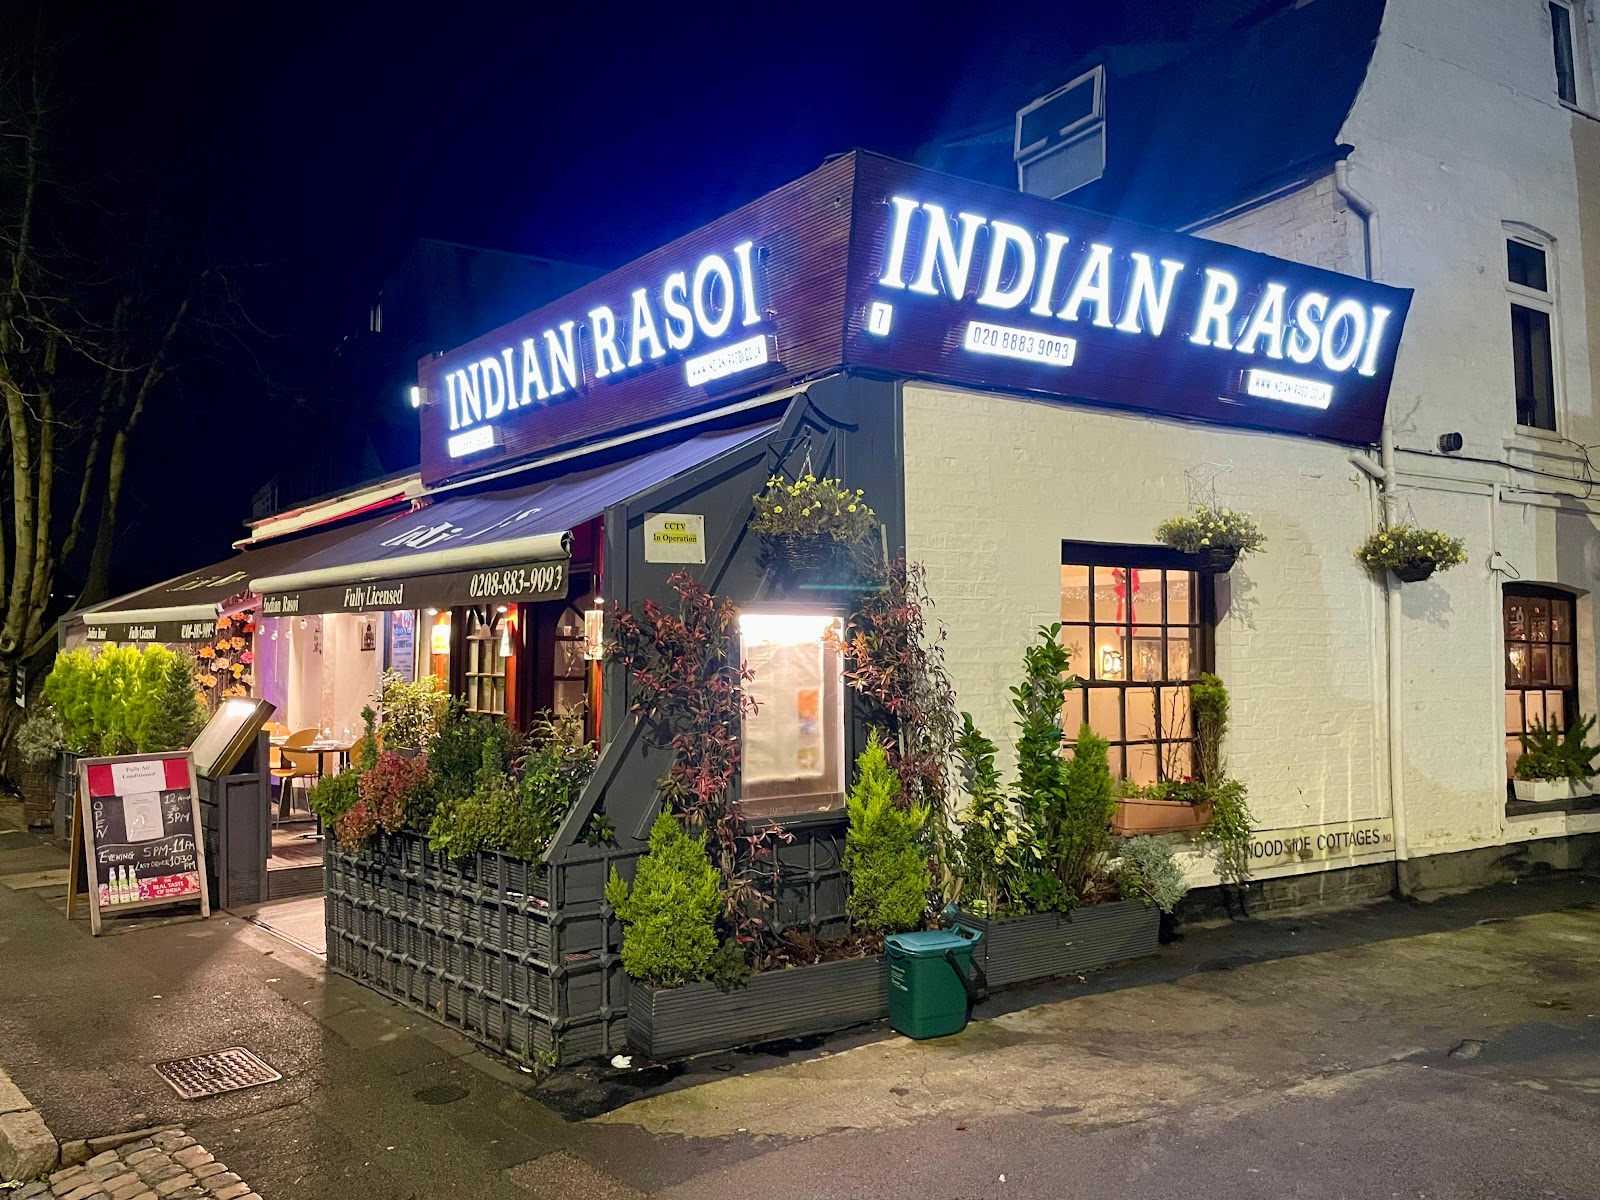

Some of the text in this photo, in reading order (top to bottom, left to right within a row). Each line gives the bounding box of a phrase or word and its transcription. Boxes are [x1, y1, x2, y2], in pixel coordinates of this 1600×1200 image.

[879, 196, 1392, 377] INDIAN RASOI
[878, 308, 884, 329] 7
[445, 240, 762, 430] INDIAN RASOI
[973, 326, 1069, 360] 020 8883 9093
[664, 522, 686, 530] CCTV
[653, 533, 697, 543] In Operation
[469, 564, 563, 598] 0208-883-9093
[263, 595, 300, 613] Indian Rasoi
[343, 584, 404, 612] Fully Licensed
[122, 771, 156, 779] Conditioned
[126, 765, 140, 773] Fully
[164, 793, 176, 804] 12
[93, 801, 108, 839] OPEN
[166, 811, 191, 824] 3PM
[1316, 828, 1380, 851] COTTAGES
[184, 860, 196, 871] PM
